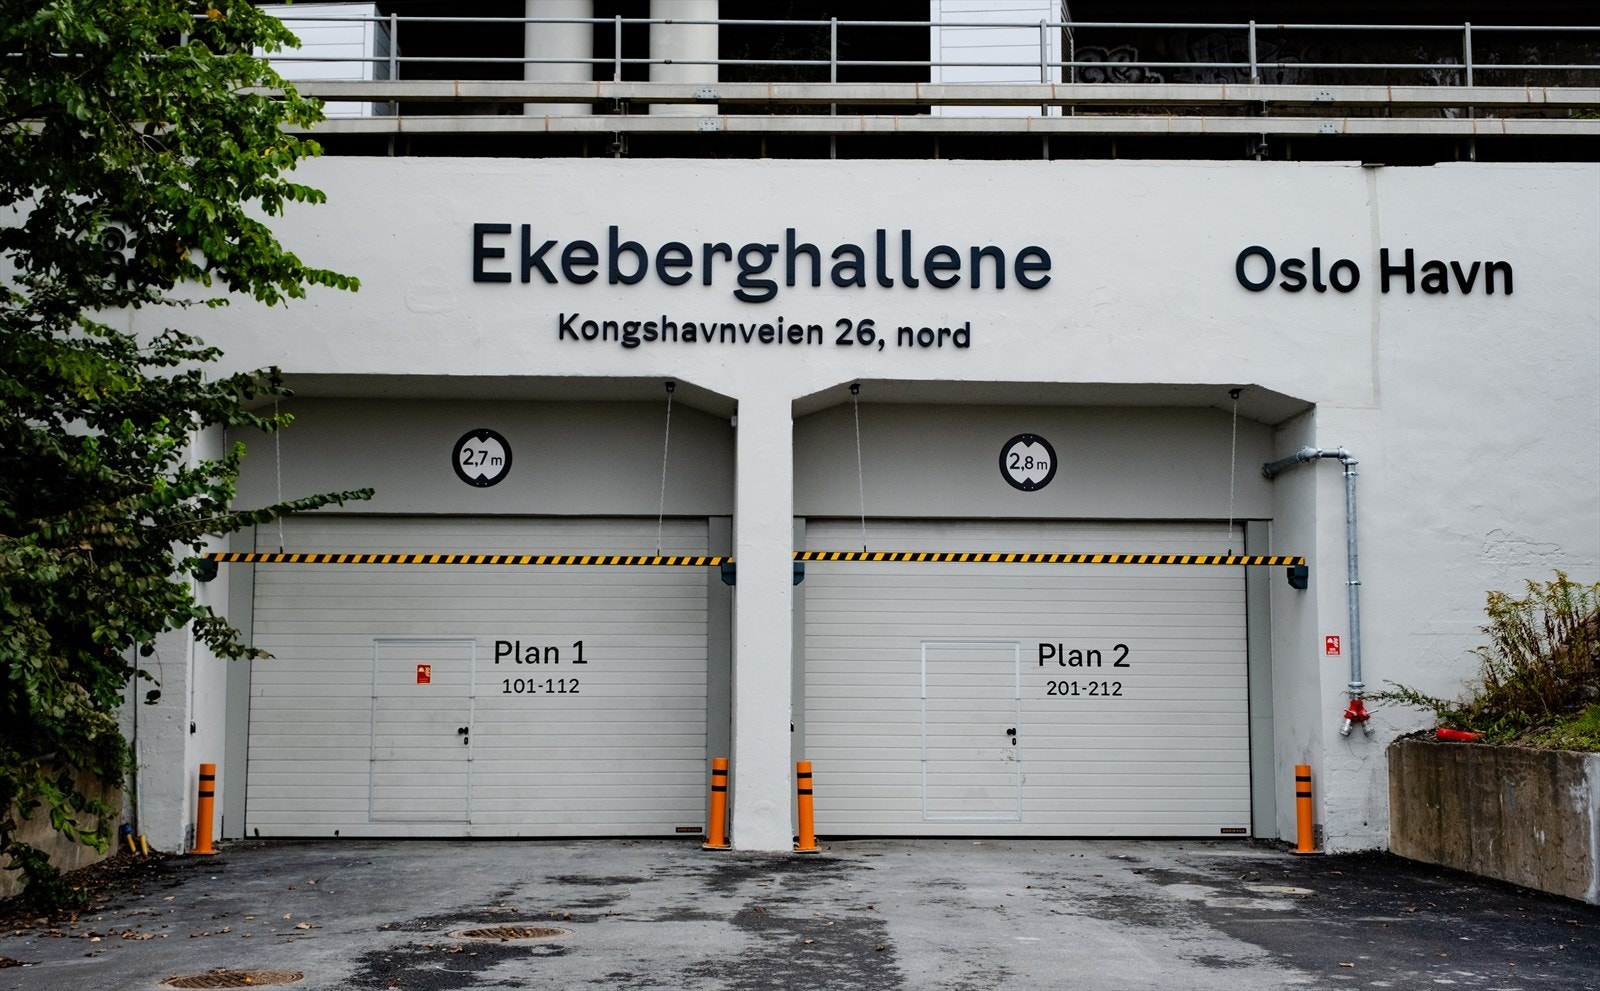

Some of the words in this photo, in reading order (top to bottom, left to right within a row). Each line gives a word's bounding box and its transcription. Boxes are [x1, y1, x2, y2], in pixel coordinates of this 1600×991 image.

[472, 222, 1052, 305] Ekeberghallene
[1235, 245, 1361, 295] Oslo
[1379, 247, 1514, 296] Havn
[558, 312, 823, 350] Kongshavnveien
[835, 317, 885, 352] 26,
[897, 321, 971, 349] nord
[462, 447, 489, 468] 2,7
[490, 456, 503, 466] m
[1009, 452, 1034, 472] 2,8
[1036, 461, 1048, 471] m
[494, 640, 560, 665] Plan
[572, 640, 588, 665] 1
[1038, 642, 1102, 668] Plan
[1112, 643, 1131, 668] 2
[502, 678, 580, 694] 101-112
[1046, 680, 1123, 697] 201-212
